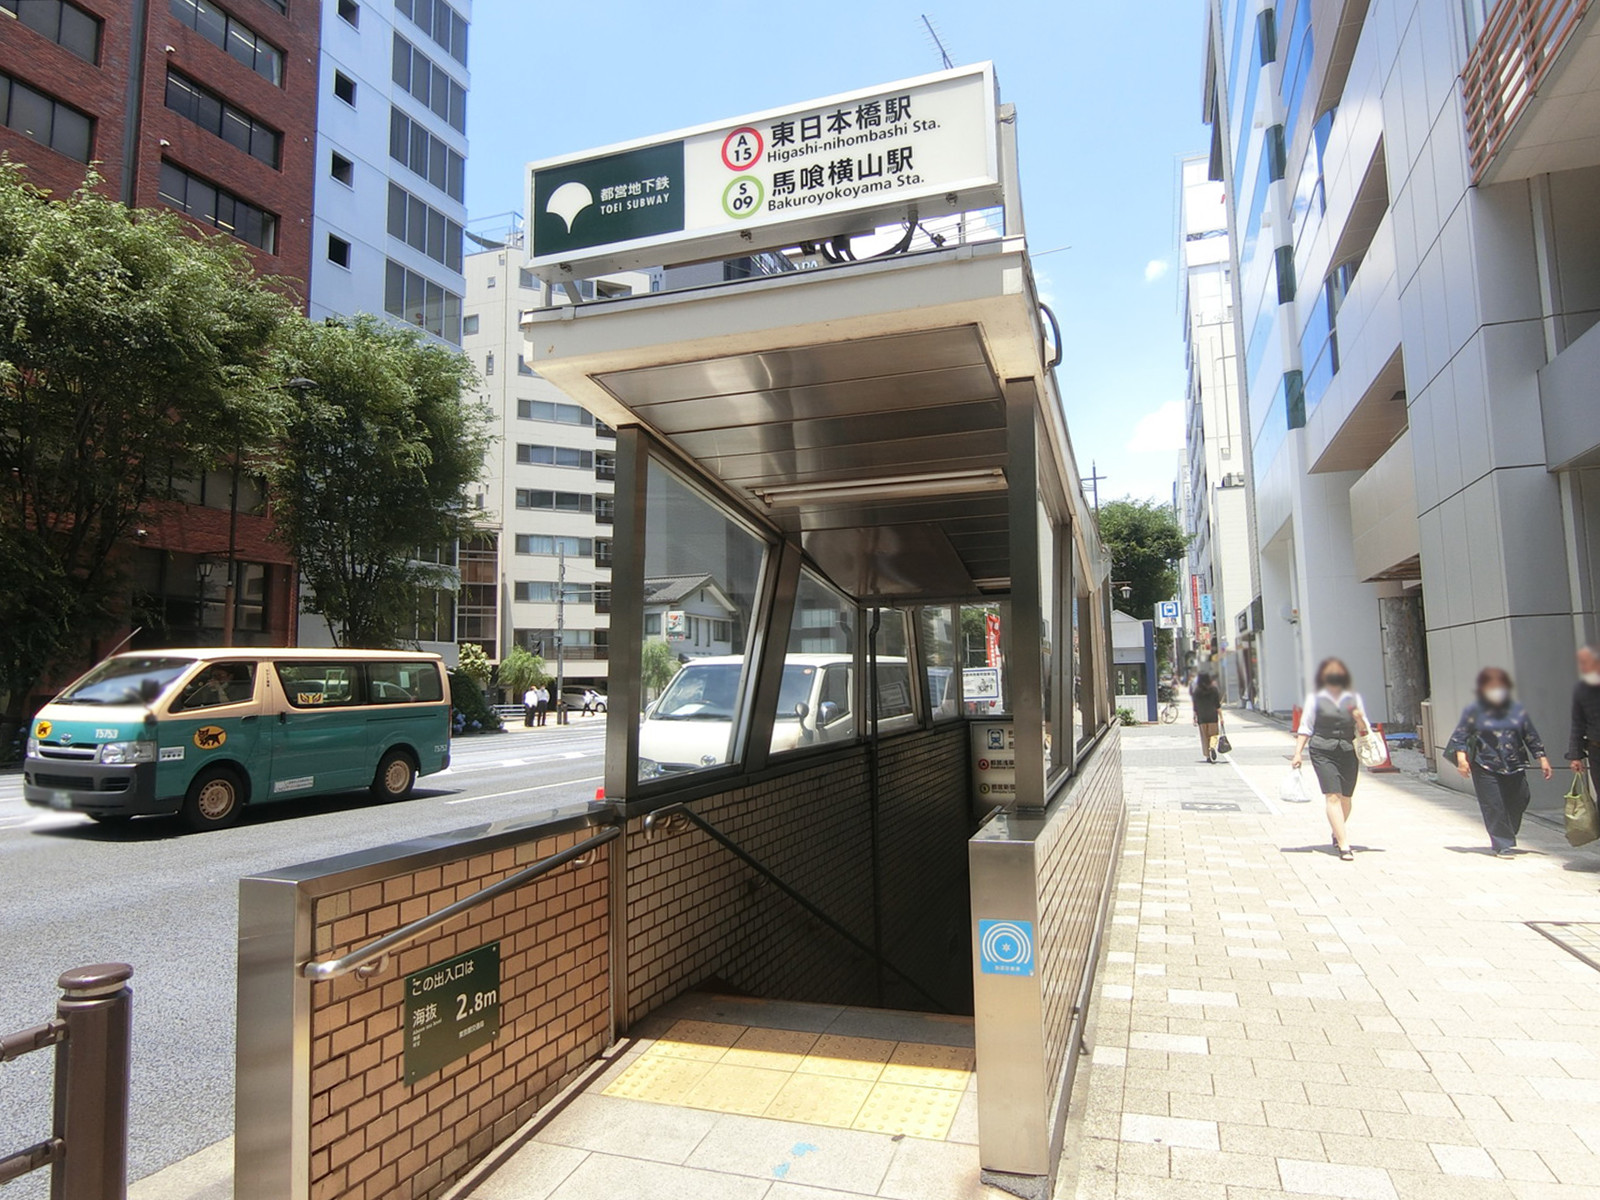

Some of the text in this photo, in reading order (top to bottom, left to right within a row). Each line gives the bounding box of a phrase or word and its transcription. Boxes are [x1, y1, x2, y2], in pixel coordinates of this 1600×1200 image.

[770, 95, 912, 148] 東日本橋駅
[734, 147, 752, 162] 15
[737, 135, 748, 148] A
[767, 119, 941, 163] Higashi-nihombashi Sta.
[772, 146, 913, 197] 馬喰横山駅
[601, 175, 670, 202] 都営地下鉄
[739, 183, 747, 195] S
[768, 173, 925, 212] Bakuroyokoyama Sta.
[600, 193, 670, 215] TOEI SUBWAY
[733, 195, 753, 211] 09
[412, 960, 474, 996] この出入口は
[412, 1003, 437, 1028] 海抜
[456, 990, 497, 1021] 2.8m
